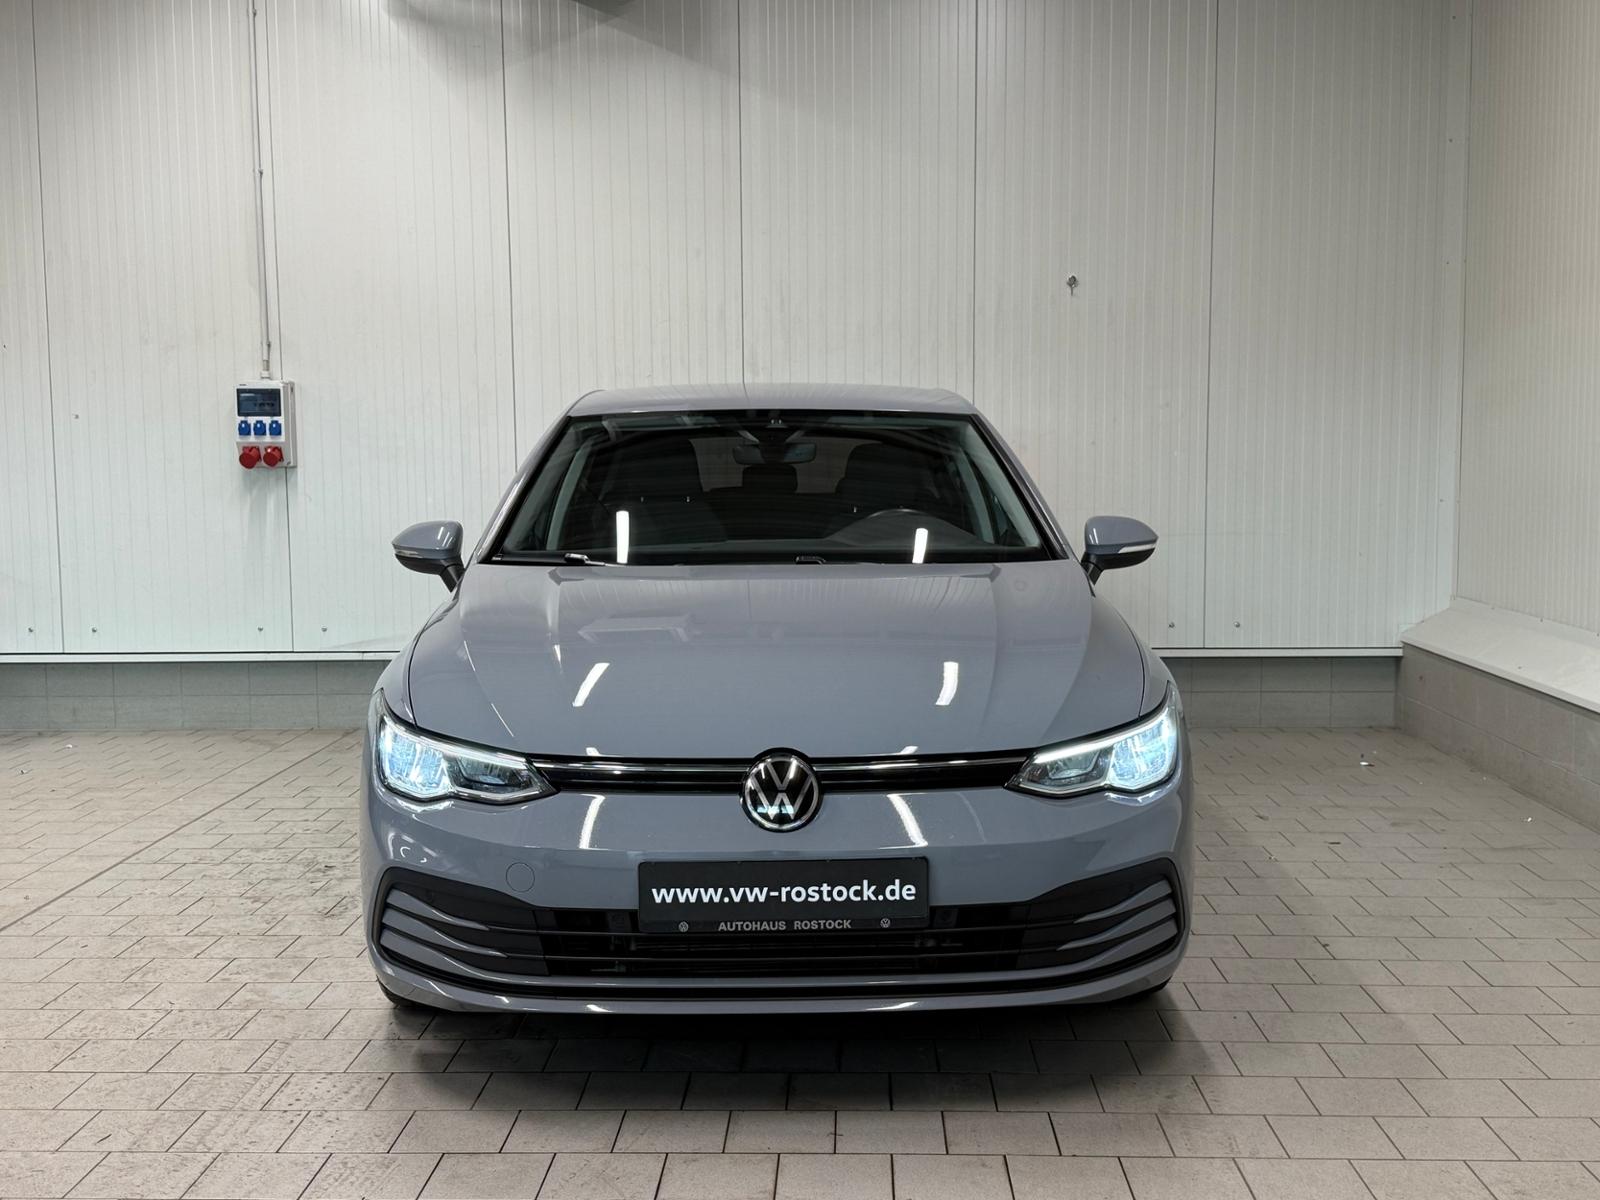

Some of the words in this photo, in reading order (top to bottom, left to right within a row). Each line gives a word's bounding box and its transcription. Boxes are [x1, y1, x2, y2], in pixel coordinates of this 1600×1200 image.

[651, 879, 916, 903] www.vw-rostock.de
[718, 920, 787, 932] AUTOHAUS
[793, 919, 852, 931] ROSTOCK
